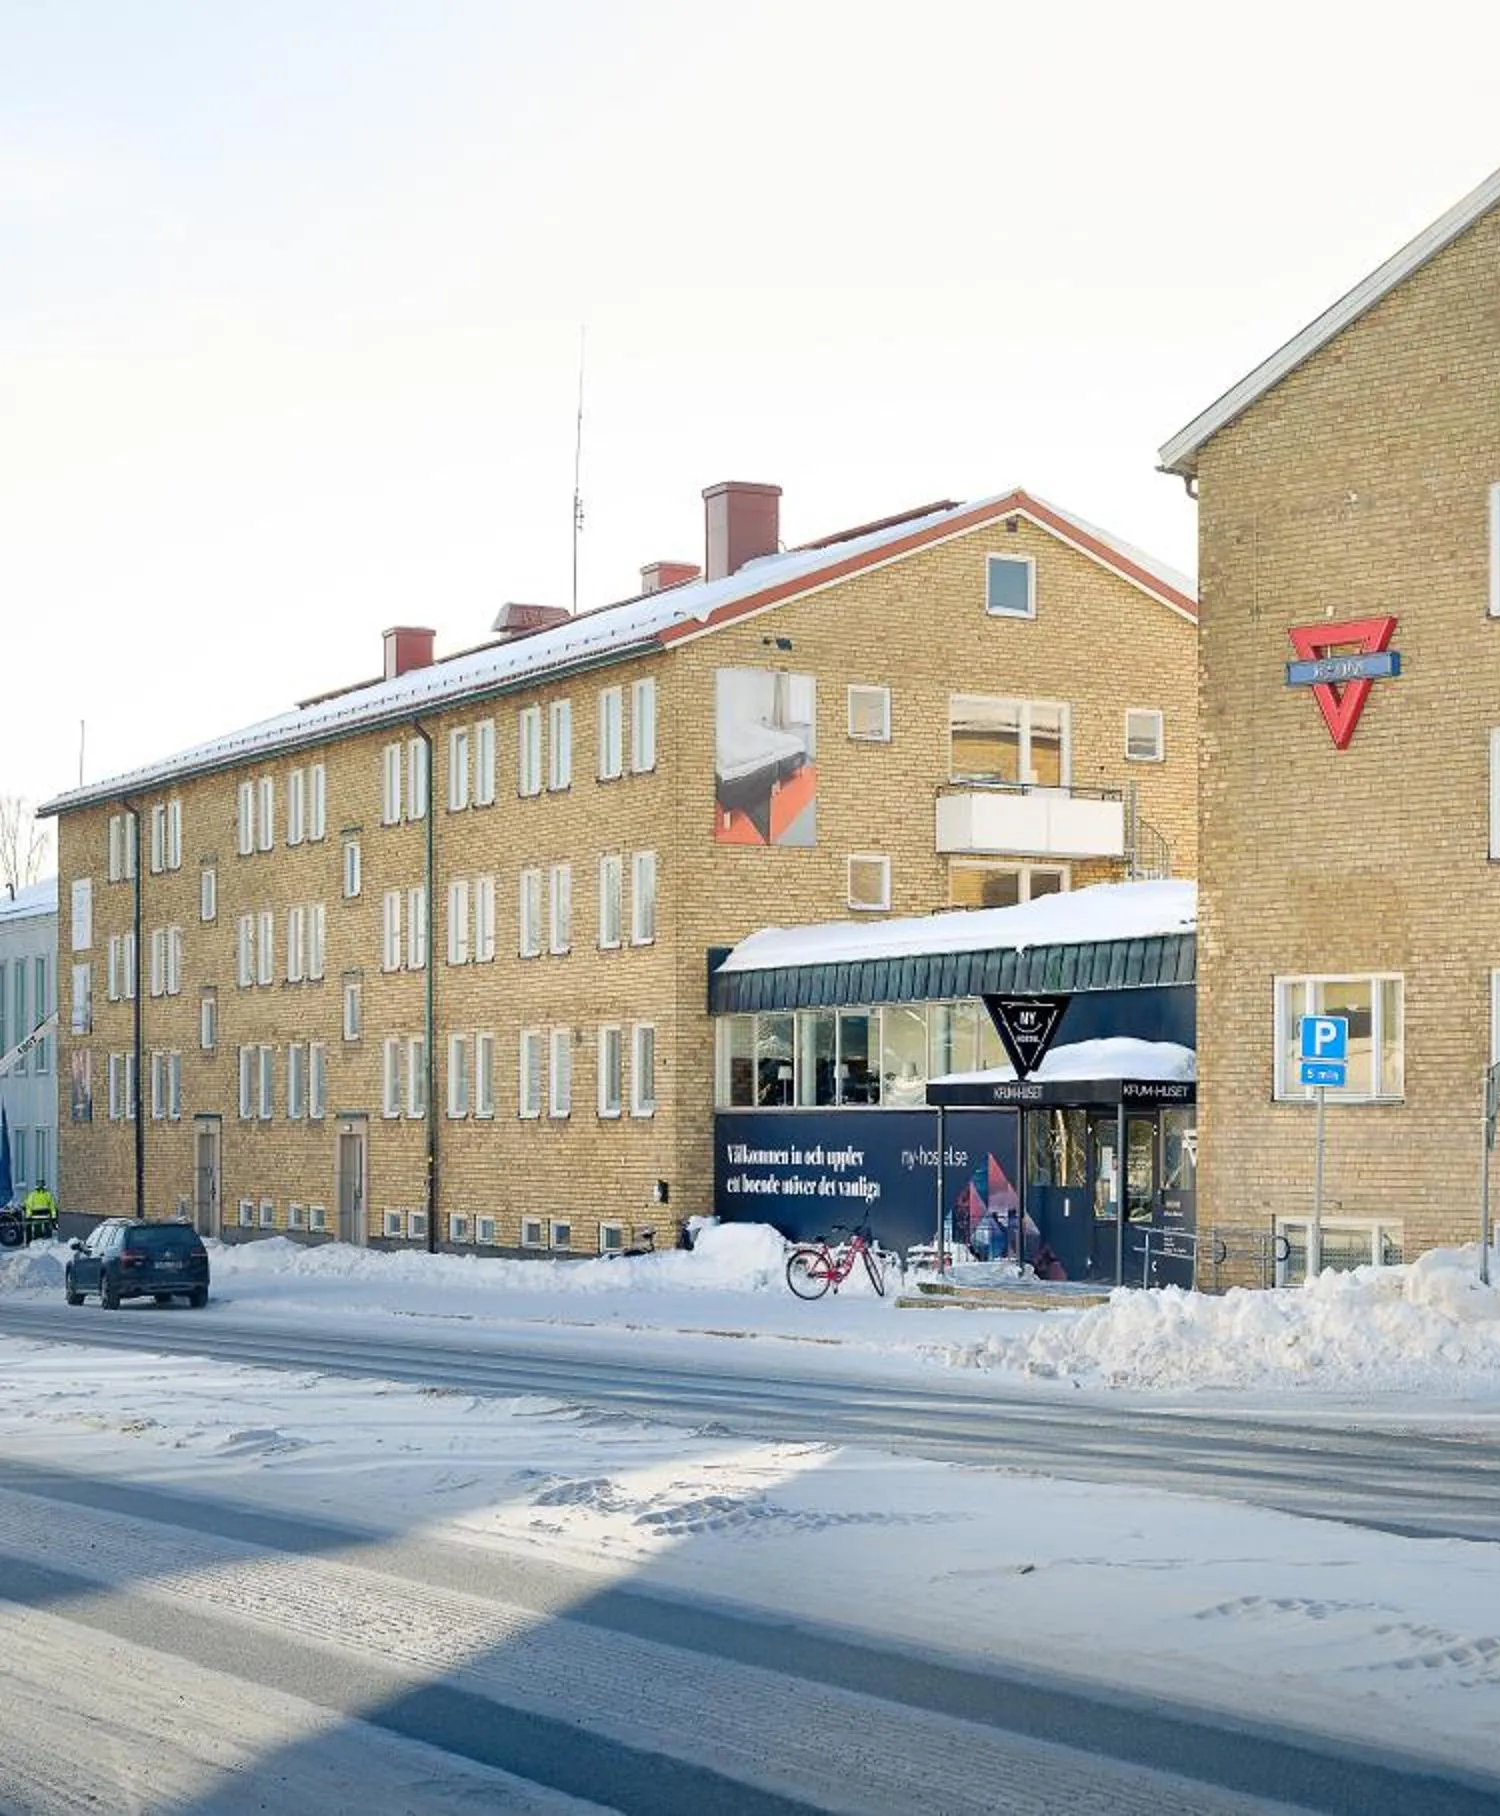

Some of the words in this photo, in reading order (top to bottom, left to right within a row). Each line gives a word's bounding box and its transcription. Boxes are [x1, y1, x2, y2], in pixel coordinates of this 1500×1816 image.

[1020, 1011, 1037, 1025] NY
[1315, 1020, 1337, 1056] P
[1123, 1084, 1188, 1098] KFUM-HUSET
[727, 1144, 788, 1165] Välkommen
[791, 1144, 802, 1165] in
[804, 1144, 824, 1165] och
[827, 1145, 864, 1172] upplev
[901, 1144, 968, 1171] ny-hosel.se
[741, 1173, 780, 1195] boende
[818, 1176, 836, 1196] det
[838, 1176, 881, 1204] vanliga
